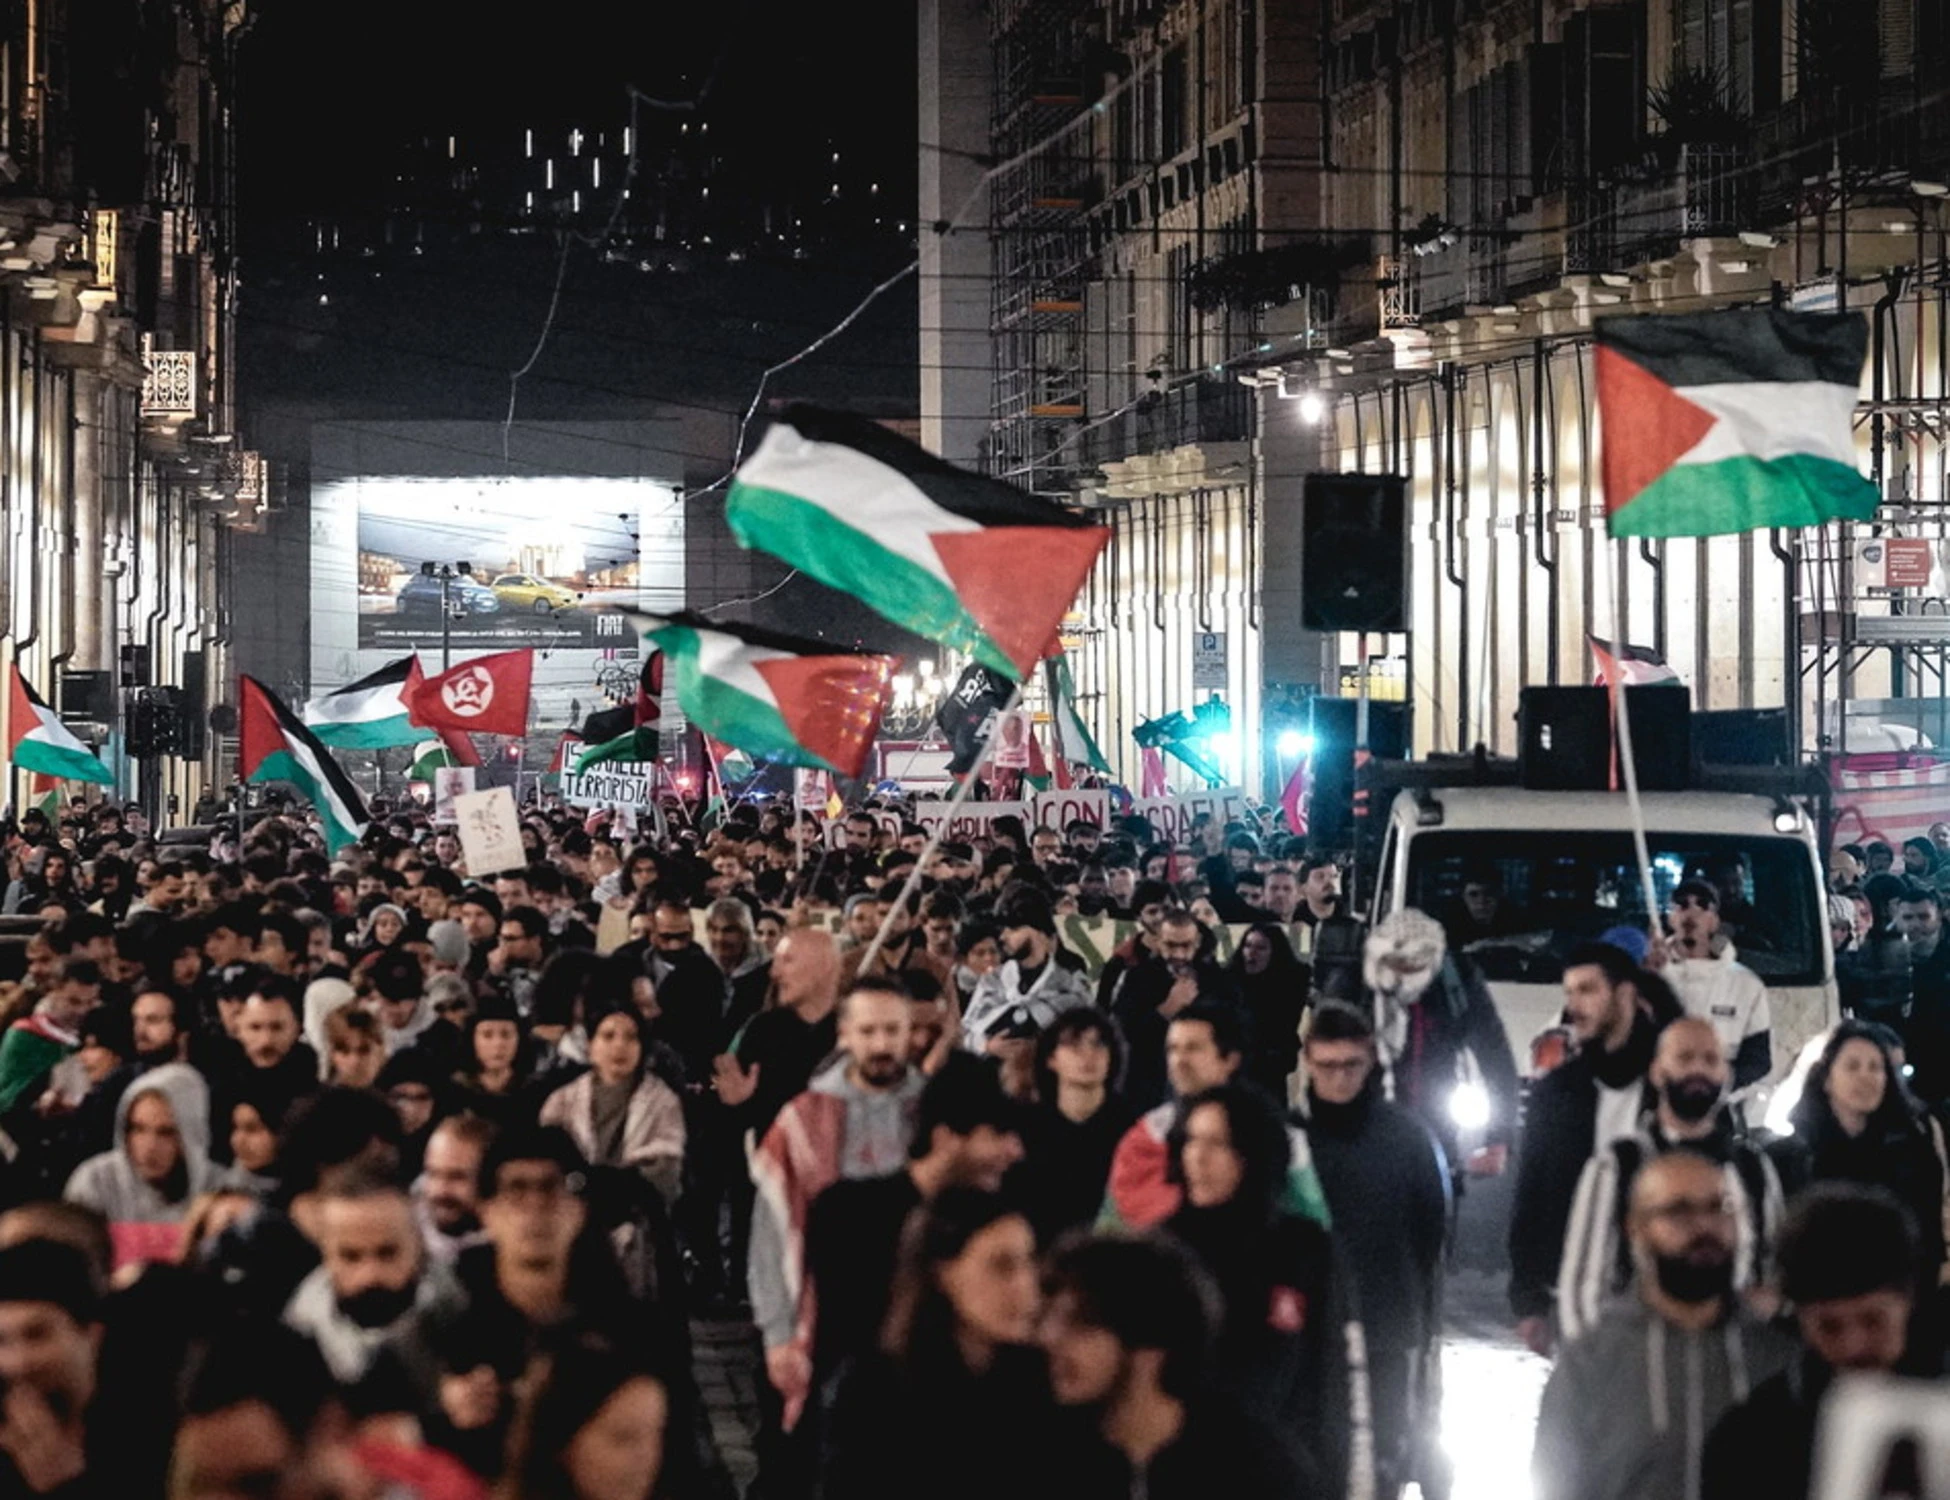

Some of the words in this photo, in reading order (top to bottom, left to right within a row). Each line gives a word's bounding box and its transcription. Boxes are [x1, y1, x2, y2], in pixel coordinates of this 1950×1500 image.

[564, 773, 650, 806] TERRORISTA
[1042, 800, 1103, 836] CON
[1139, 796, 1240, 846] SRAEE
